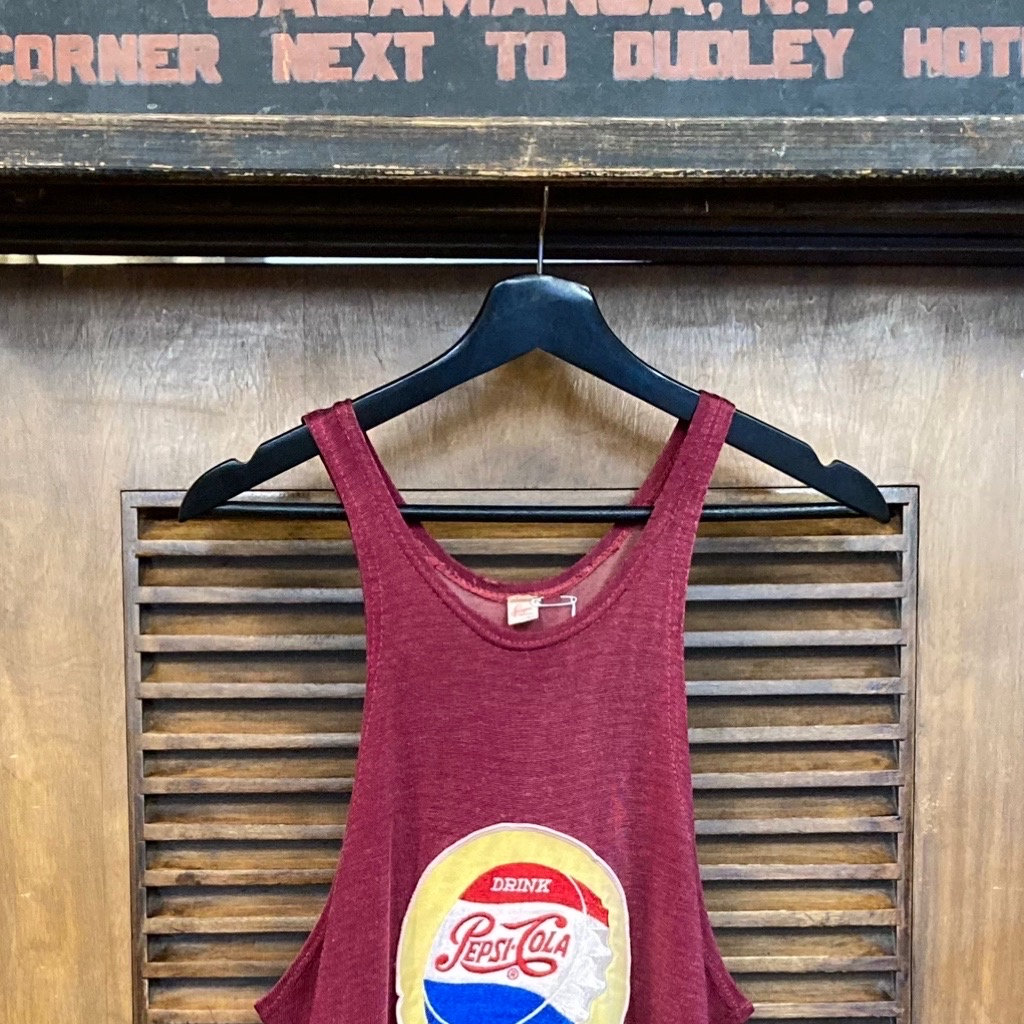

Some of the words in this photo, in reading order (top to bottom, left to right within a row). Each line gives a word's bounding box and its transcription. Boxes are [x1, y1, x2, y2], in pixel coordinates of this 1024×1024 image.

[271, 32, 434, 83] NEXT
[485, 31, 566, 80] TO
[613, 28, 854, 80] DUDLEY
[490, 876, 552, 893] DRINK
